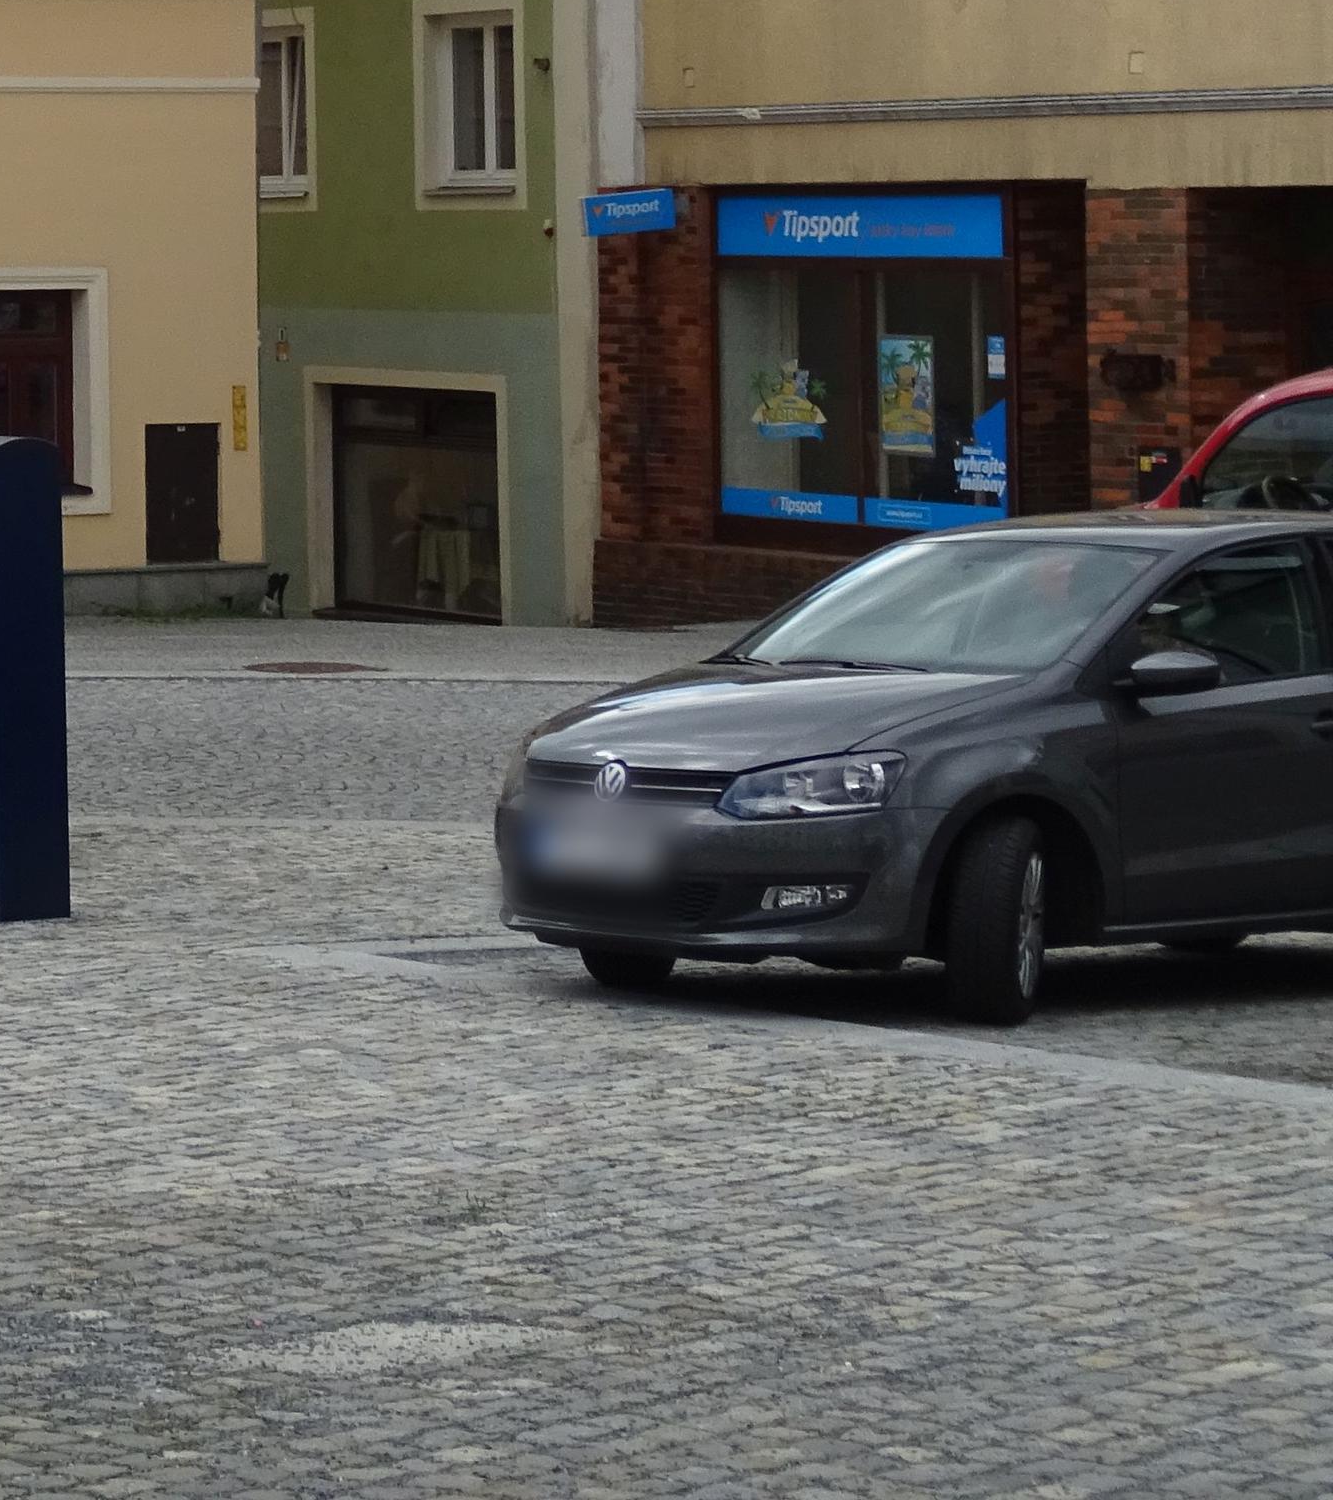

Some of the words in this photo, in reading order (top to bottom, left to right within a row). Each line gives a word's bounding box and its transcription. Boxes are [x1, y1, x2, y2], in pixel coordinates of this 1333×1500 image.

[605, 198, 660, 219] Tipsport
[783, 209, 860, 243] Tipsport
[953, 455, 1007, 478] vyhrajte
[959, 473, 1007, 498] miliony
[778, 495, 823, 516] Tipsport
